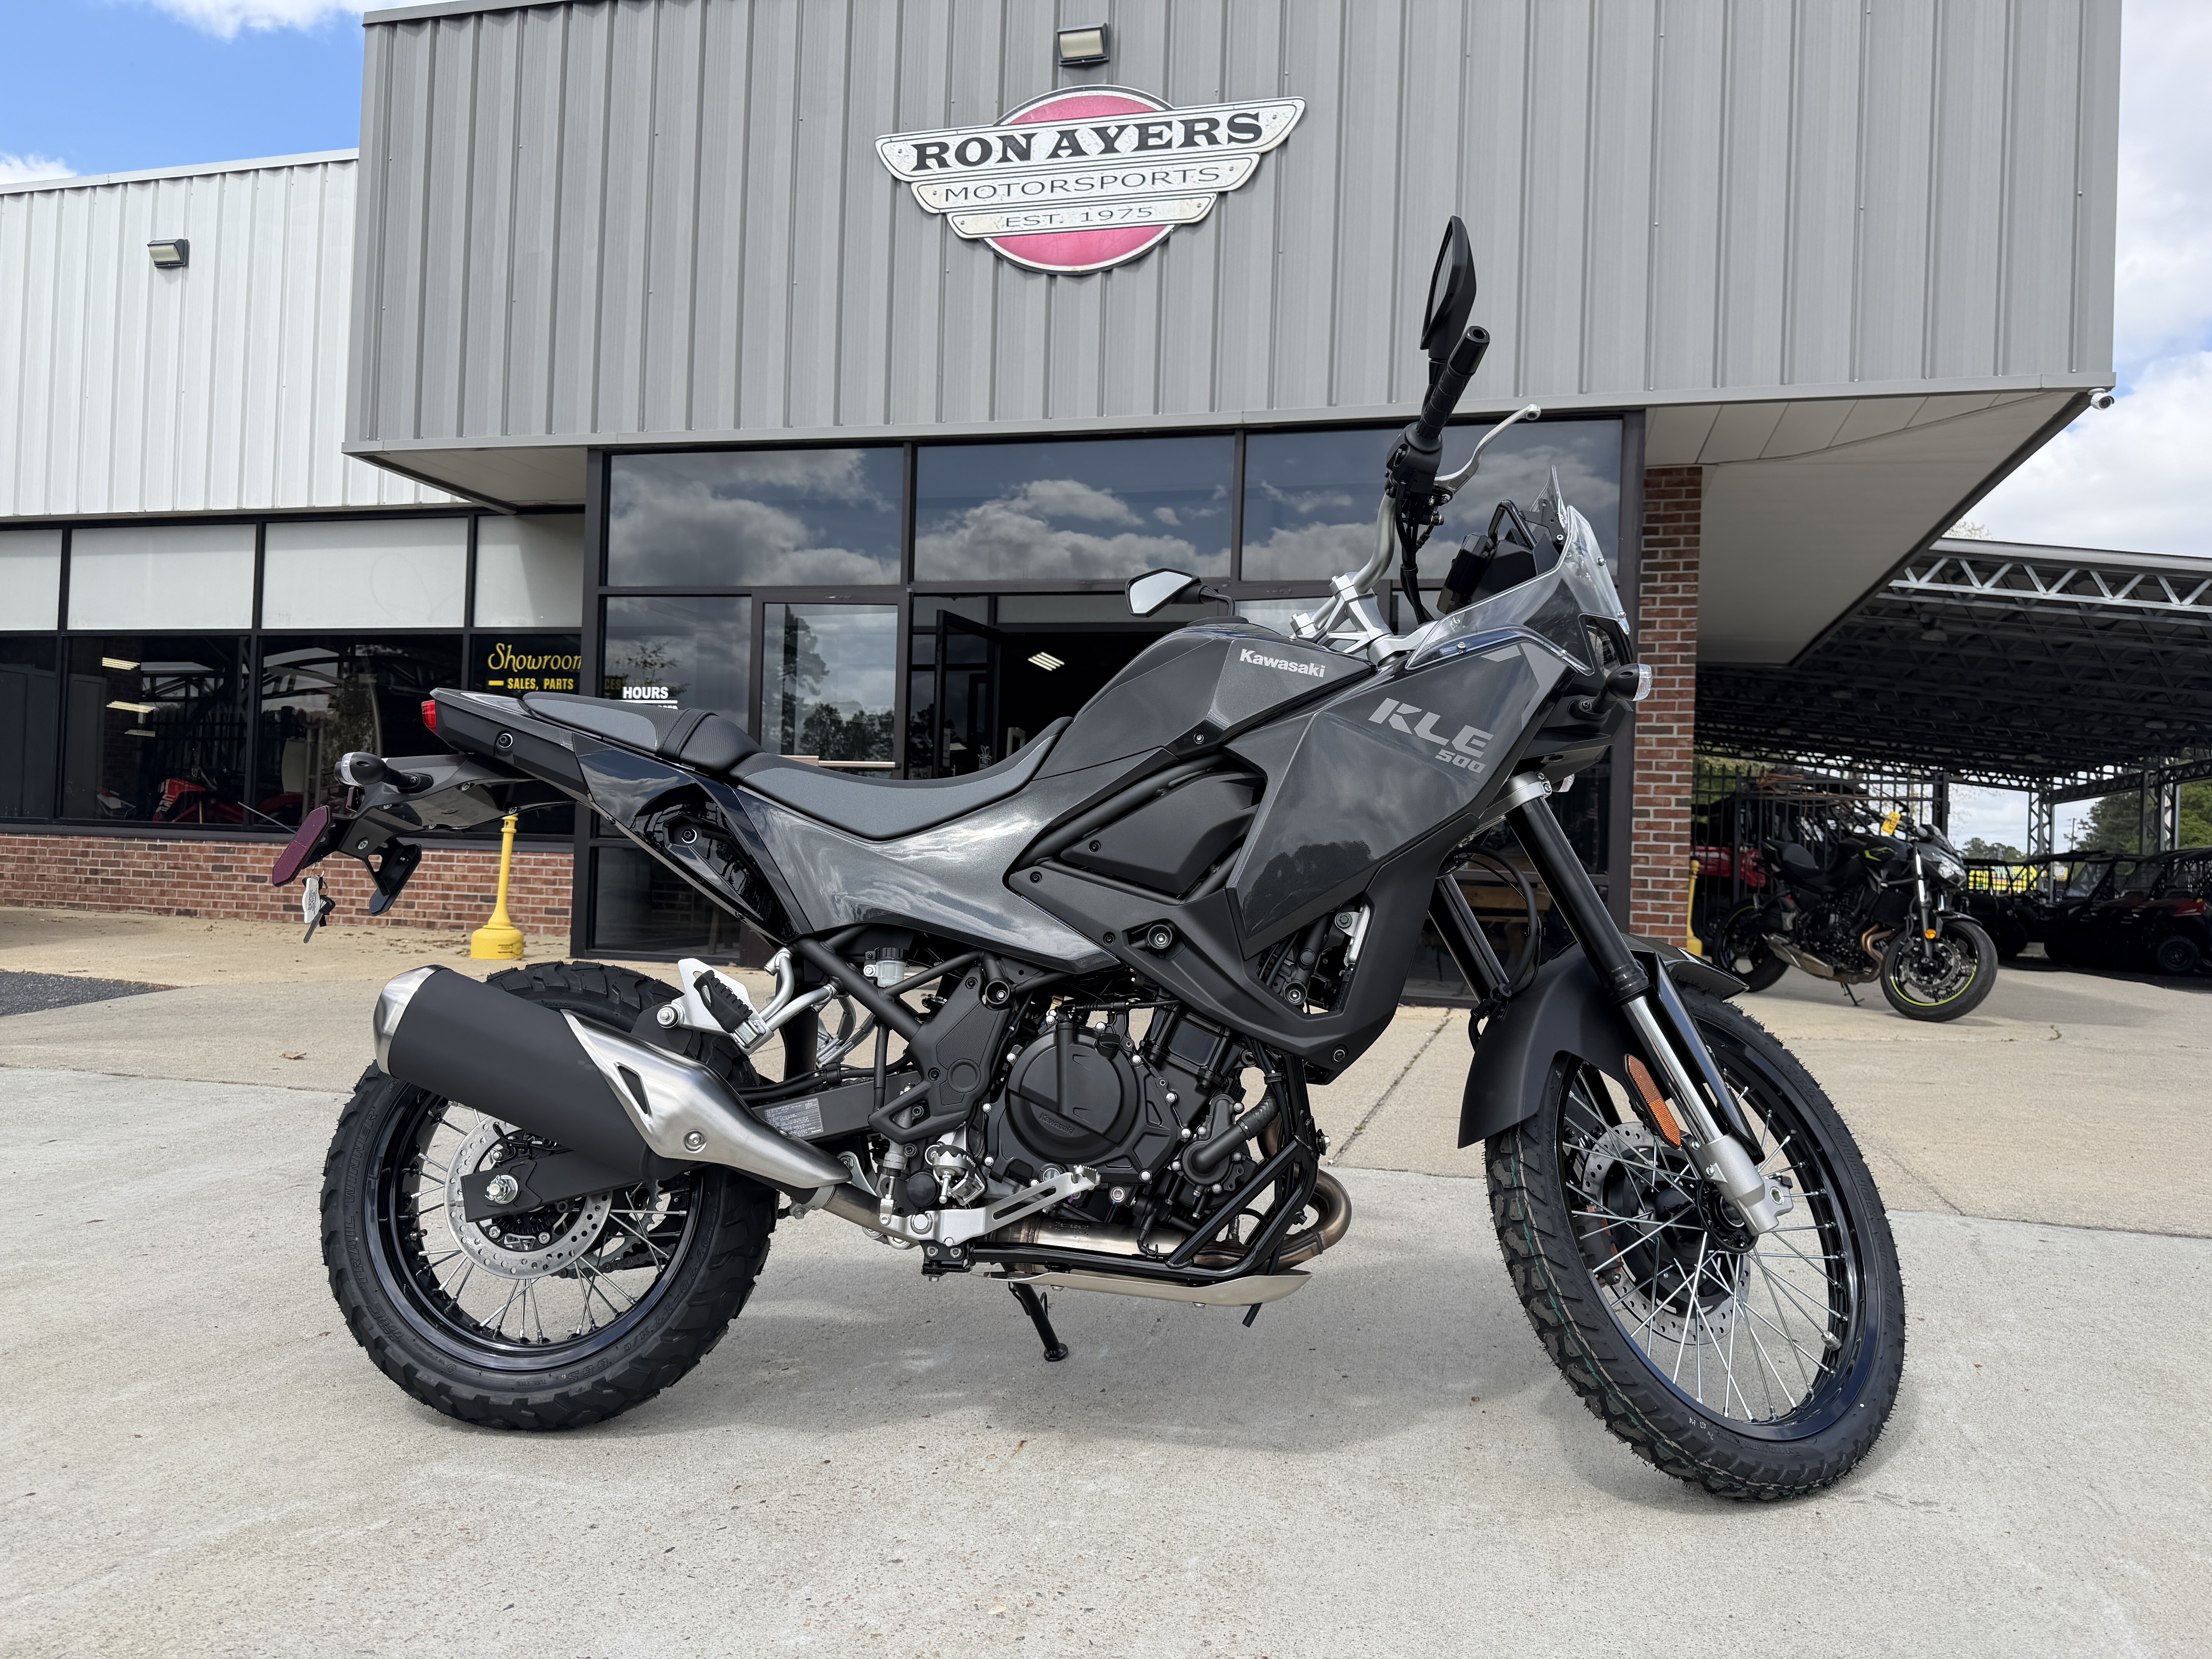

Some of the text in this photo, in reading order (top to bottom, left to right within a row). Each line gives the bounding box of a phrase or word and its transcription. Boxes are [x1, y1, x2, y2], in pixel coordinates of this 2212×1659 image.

[910, 112, 1262, 171] RON AYERS
[945, 166, 1220, 202] MOTORSPORTS
[1006, 207, 1153, 228] EST. 1975
[1240, 649, 1326, 678] Kawasaki
[507, 678, 574, 691] SALES, PARTS
[623, 686, 669, 699] HOURS
[1368, 697, 1494, 758] KLE
[1435, 749, 1486, 773] 500
[1039, 1112, 1075, 1134] Kawasaki
[345, 1109, 378, 1288] TRAIL WINNER
[567, 1358, 608, 1384] 66S
